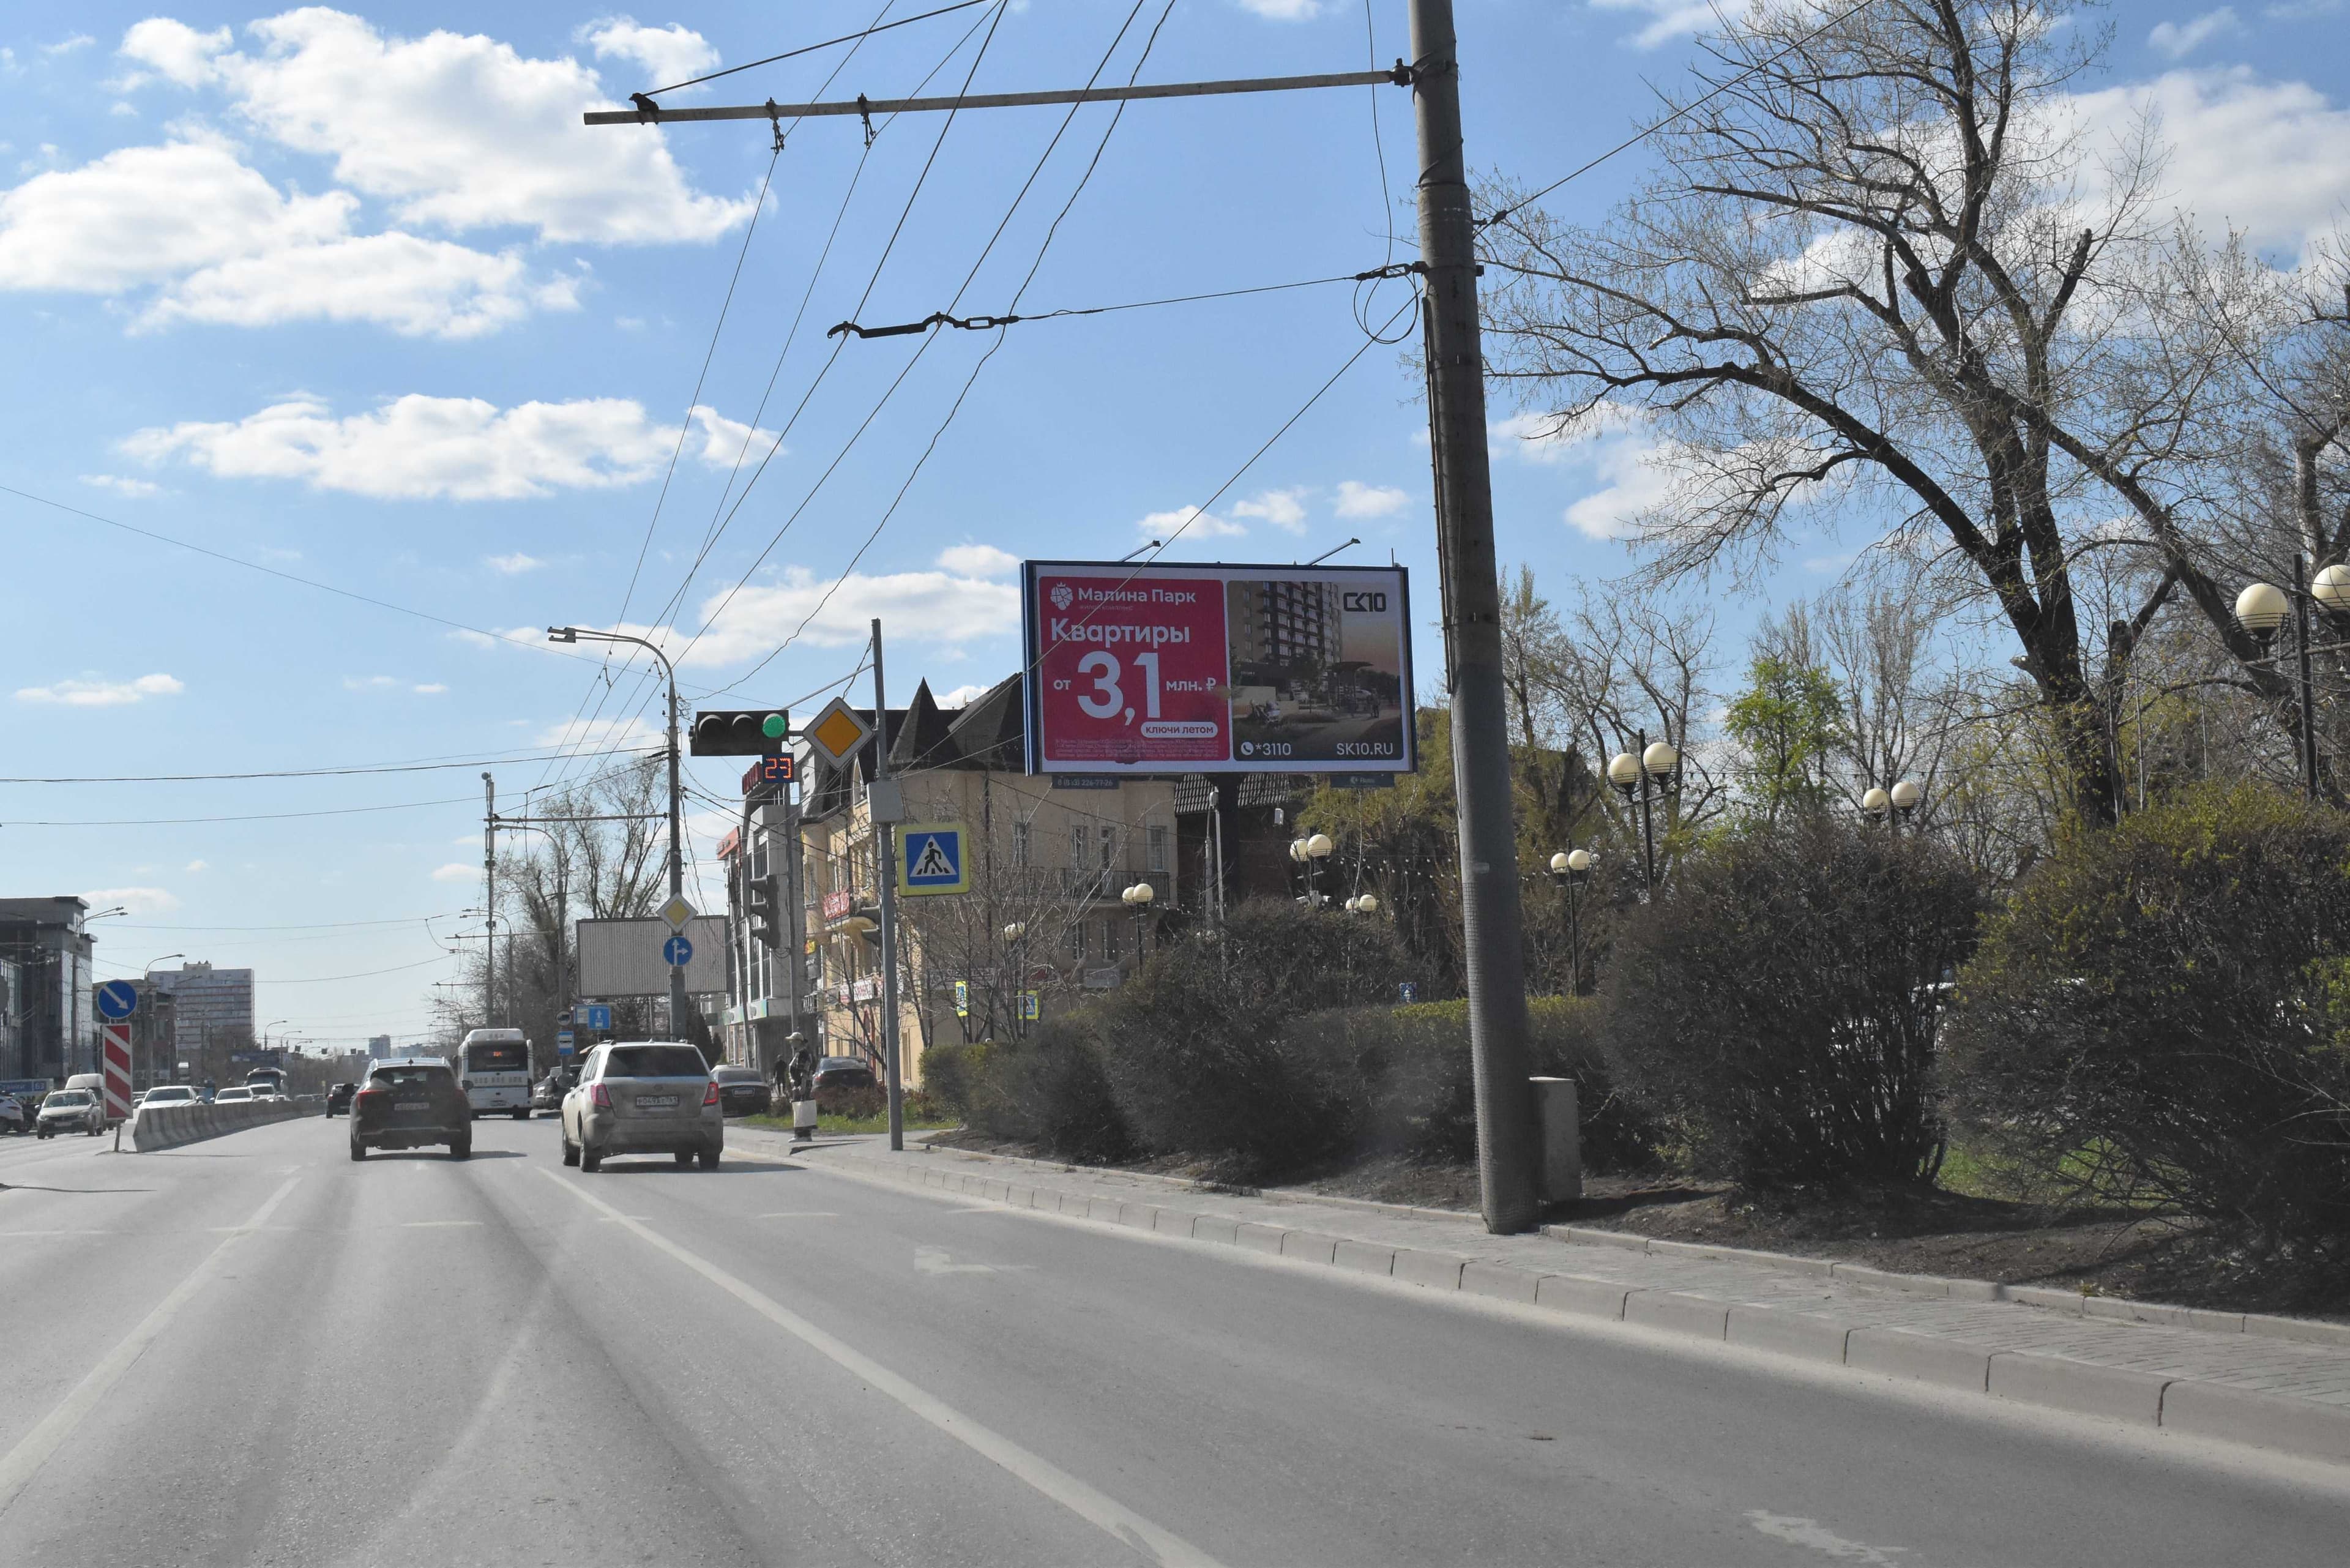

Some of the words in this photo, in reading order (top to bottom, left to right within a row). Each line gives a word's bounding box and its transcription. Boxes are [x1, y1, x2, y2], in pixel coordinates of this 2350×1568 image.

[1078, 588, 1147, 602] Малина
[1152, 589, 1196, 605] Парк
[1051, 618, 1190, 649] Квартиры
[1053, 679, 1071, 690] от
[1077, 651, 1161, 726] 3,1
[1166, 681, 1203, 691] млн.
[1336, 742, 1393, 756] SK10.RU
[765, 758, 793, 779] 23
